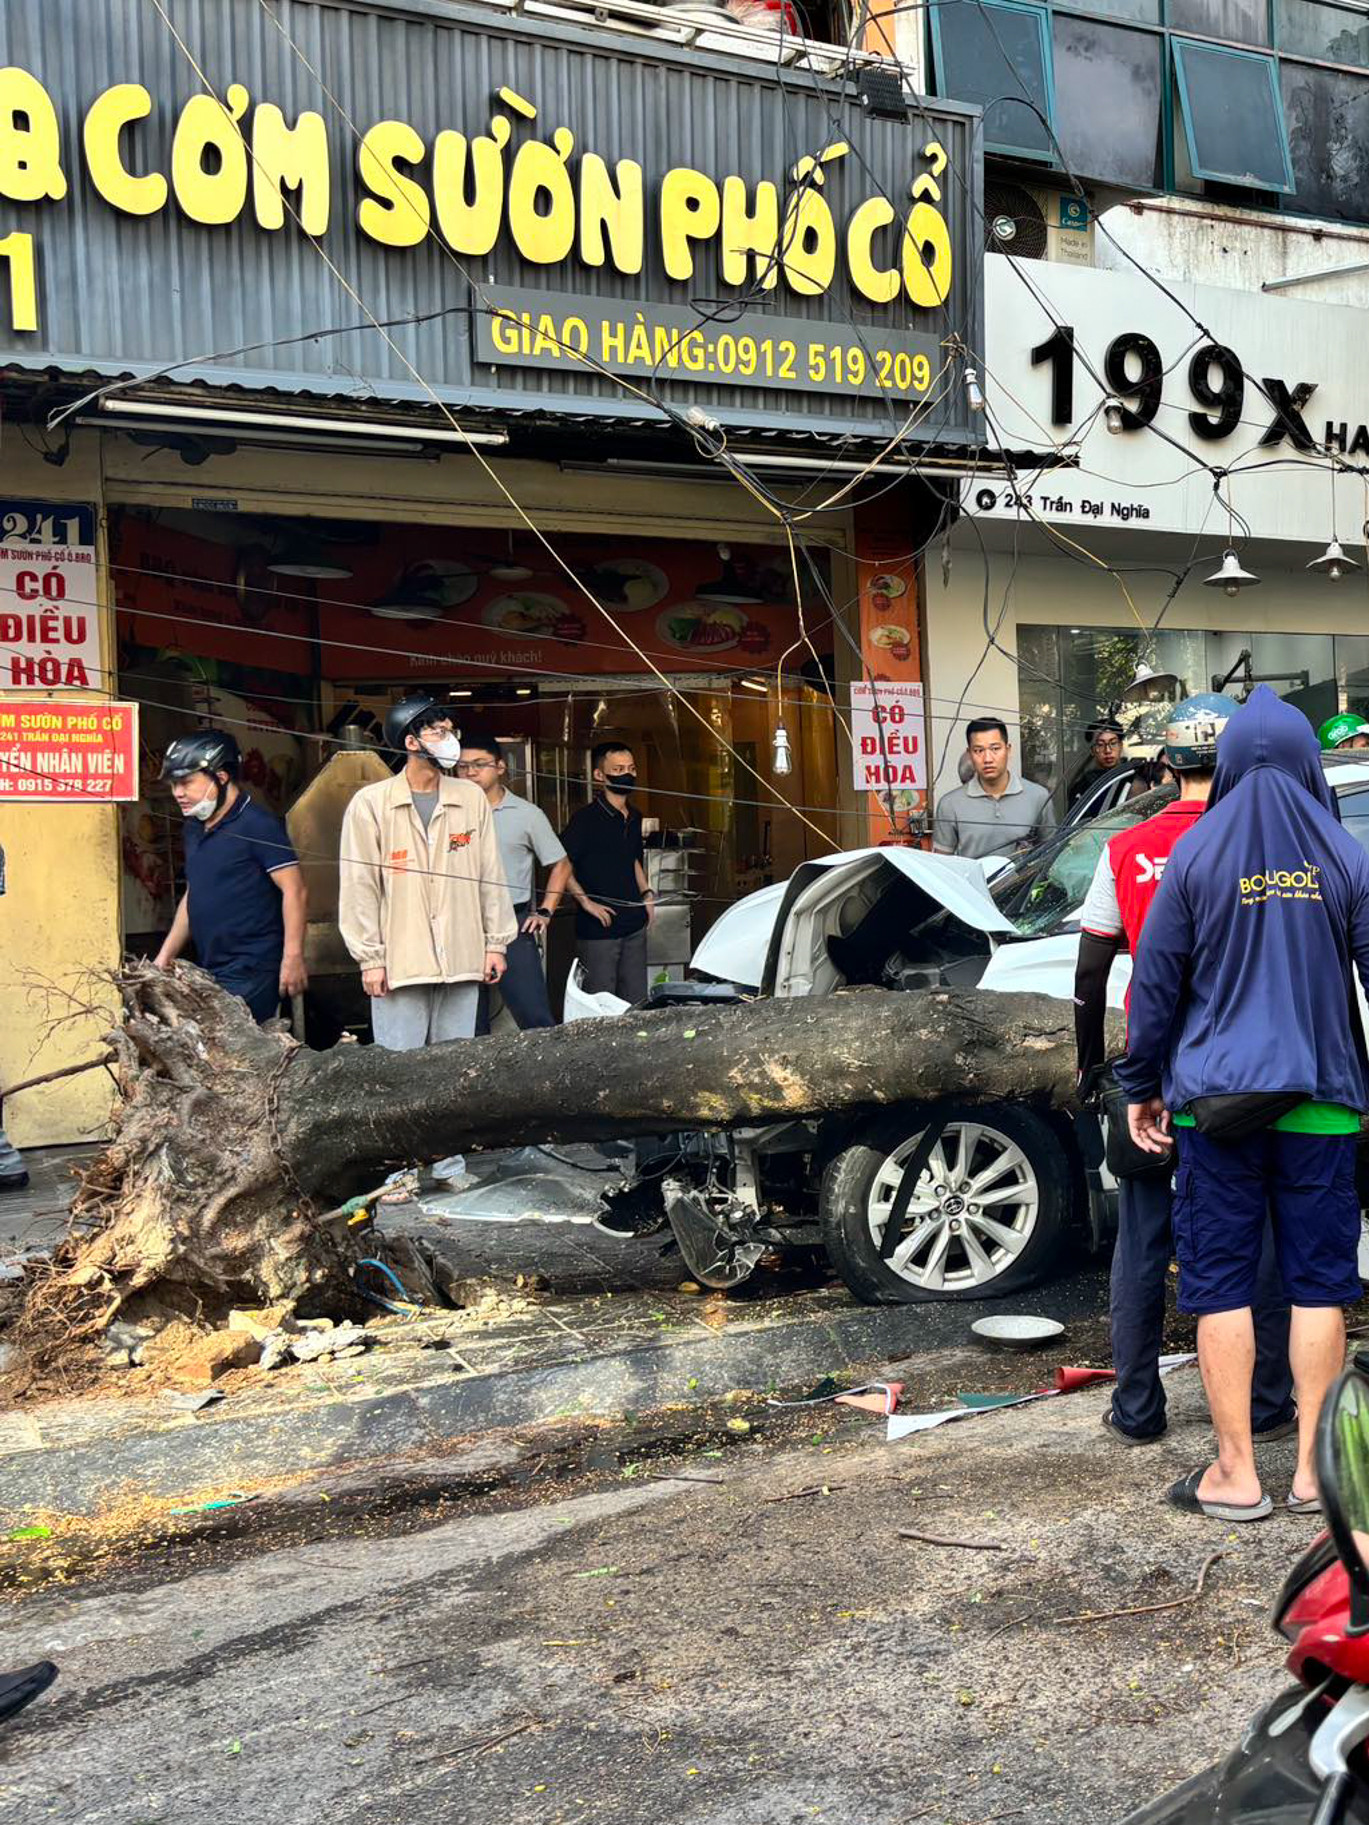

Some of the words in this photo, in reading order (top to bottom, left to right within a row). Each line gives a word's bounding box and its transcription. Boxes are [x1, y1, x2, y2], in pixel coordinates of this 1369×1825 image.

[83, 82, 331, 237] CƠM
[357, 86, 643, 275] SƯỜN
[660, 141, 850, 296] PHỐ
[846, 142, 953, 308] CỔ
[1060, 236, 1079, 247] Made
[491, 308, 589, 362] GIAO
[807, 343, 866, 387] 519
[875, 351, 932, 392] 209
[1110, 502, 1150, 521] Nghĩa
[3, 512, 80, 546] 241
[15, 565, 66, 602] CÓ
[0, 605, 86, 645] ĐIỀU
[11, 650, 90, 687] HÒA
[21, 711, 62, 729] SƯỜN
[67, 711, 97, 730] PHỐ
[102, 712, 123, 731] CỔ
[871, 699, 905, 724] CÓ
[860, 729, 918, 755] ĐIỀU
[37, 747, 83, 773] NHÂN
[88, 749, 124, 774] VIÊN
[865, 760, 917, 784] HÒA
[18, 779, 53, 791] 0915
[86, 779, 112, 792] 227
[1240, 869, 1319, 894] BOUGOL
